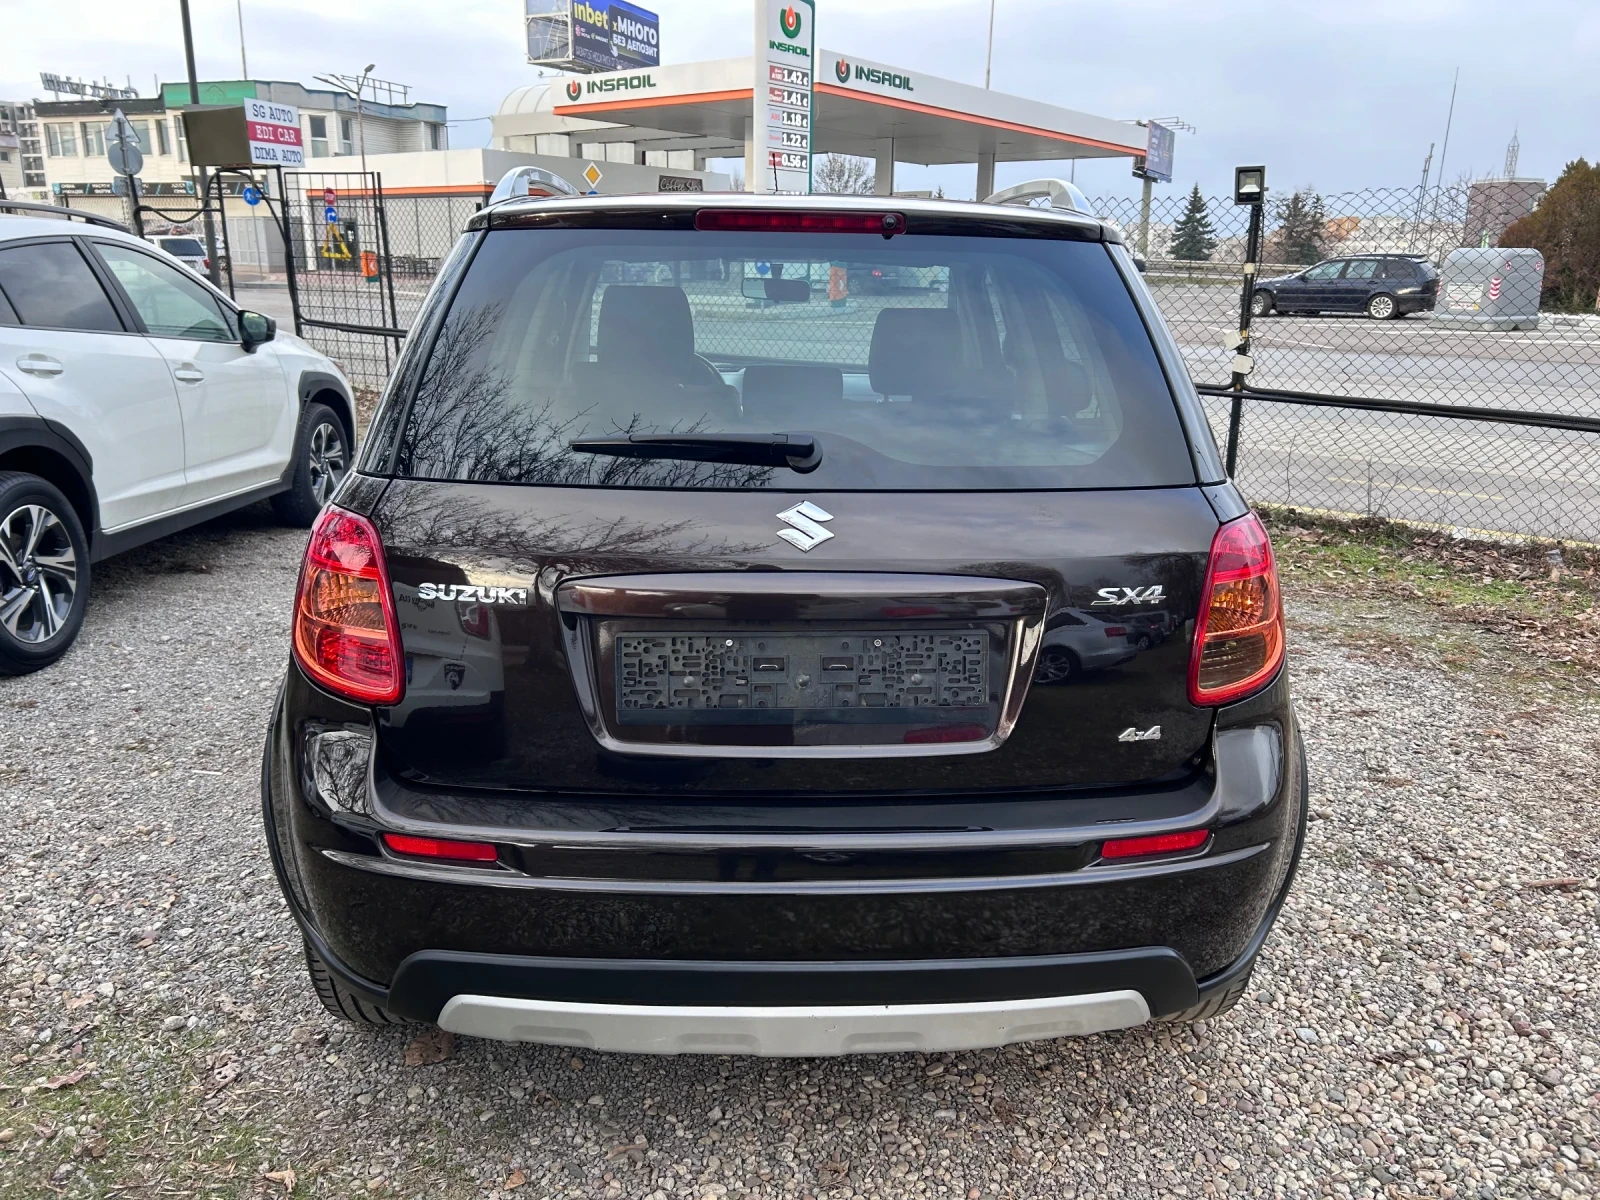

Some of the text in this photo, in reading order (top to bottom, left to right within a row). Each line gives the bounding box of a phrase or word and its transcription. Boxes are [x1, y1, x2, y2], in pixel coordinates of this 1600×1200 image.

[574, 0, 608, 30] inbet
[613, 34, 626, 47] БЕЗ
[627, 39, 657, 57] ДЕПОЗИТ
[769, 40, 810, 57] INSAOIL
[587, 75, 656, 93] INSAOIL
[783, 69, 803, 85] 1.42
[855, 65, 914, 91] INSAOIL
[783, 91, 802, 105] 1.41
[252, 104, 293, 123] SG AUTO
[782, 112, 802, 126] 1.18
[255, 125, 297, 142] EDI CAR
[782, 133, 801, 147] 1.22
[254, 147, 302, 163] DIMA AUTO
[782, 154, 801, 167] 0.56
[418, 582, 528, 605] SUZUKI
[1091, 585, 1166, 605] SX4
[1118, 725, 1162, 742] 4x4
